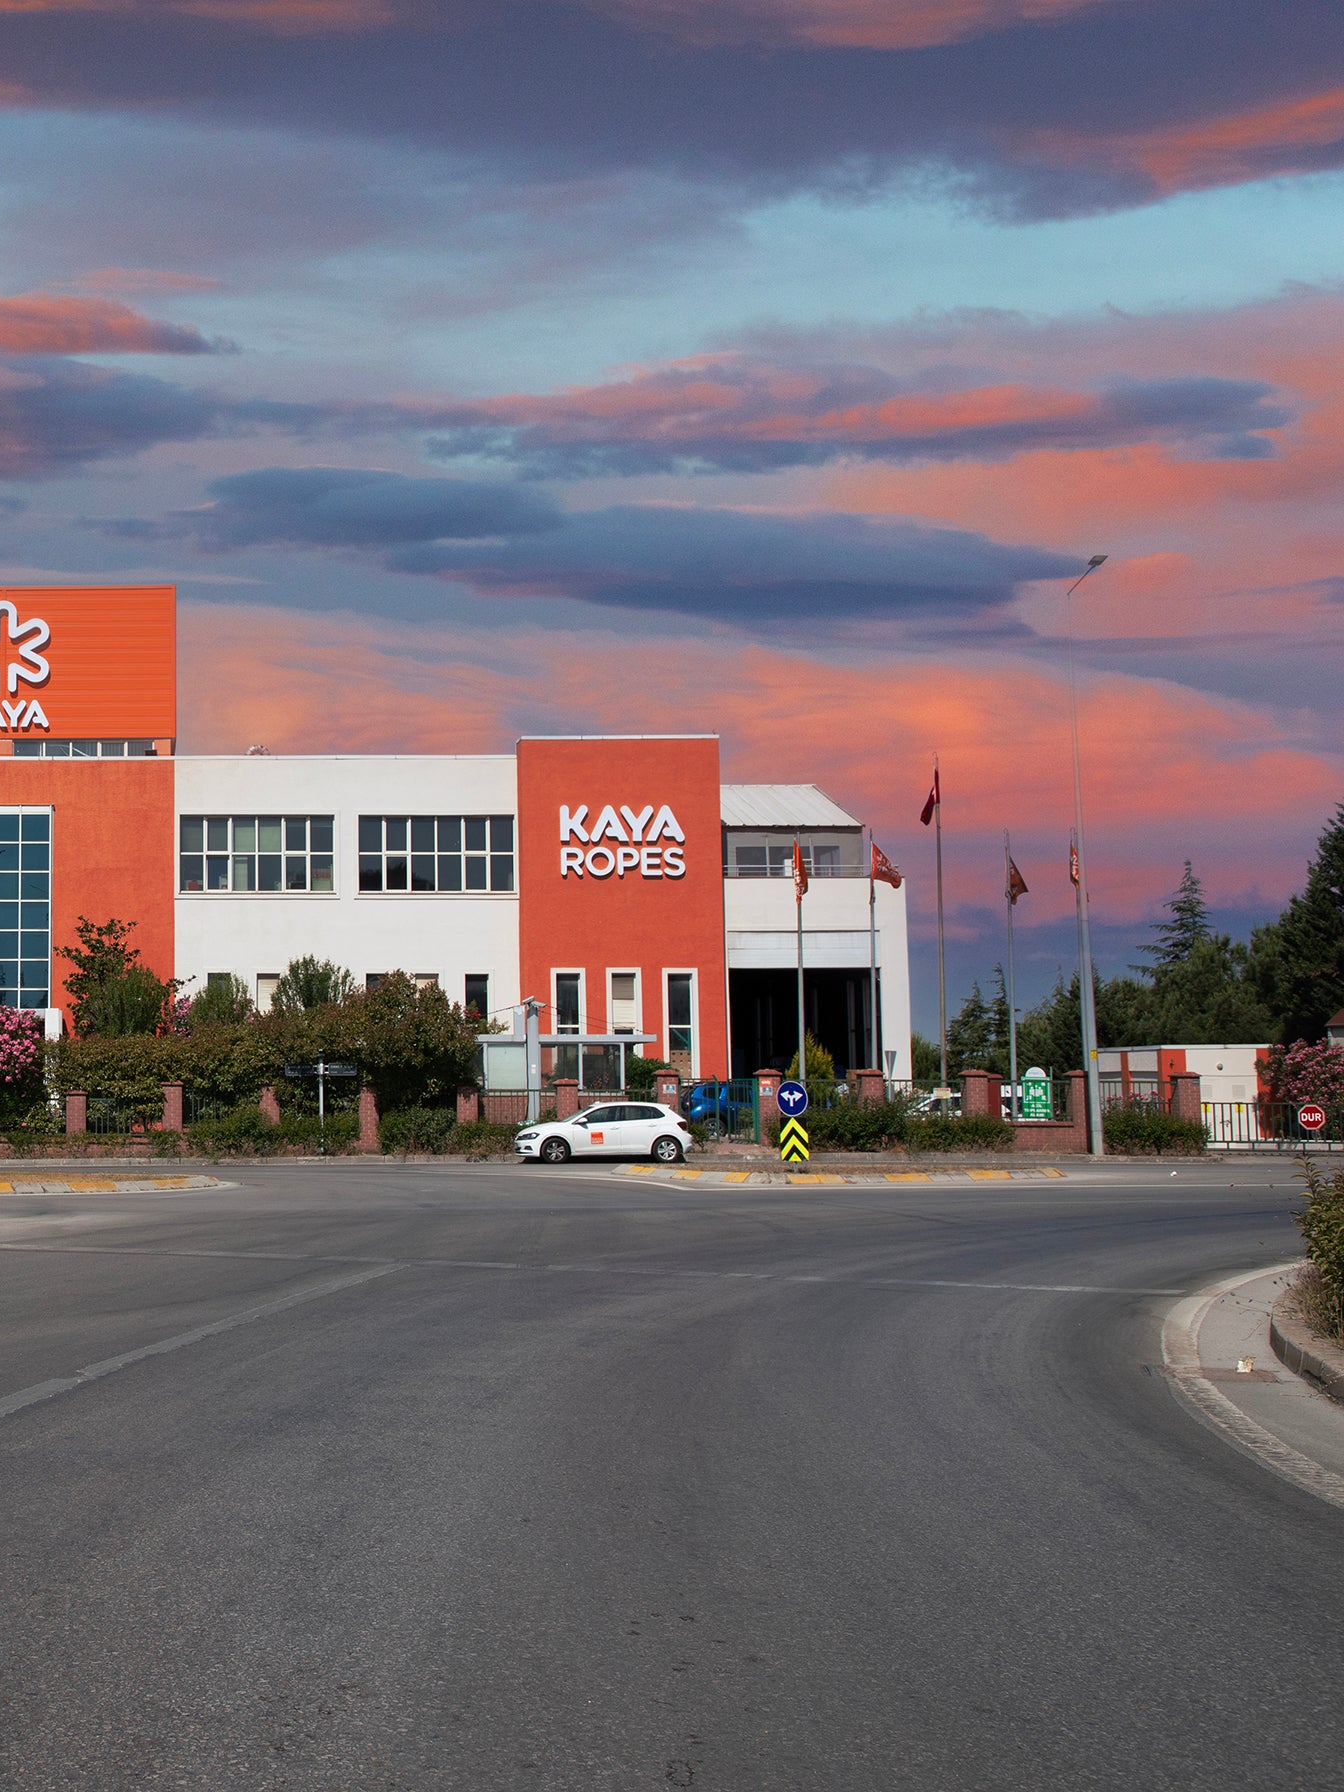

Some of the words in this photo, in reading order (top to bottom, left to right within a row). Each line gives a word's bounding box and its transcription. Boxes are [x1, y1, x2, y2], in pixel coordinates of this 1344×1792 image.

[559, 804, 686, 843] KAYA
[560, 846, 686, 877] ROPES
[1301, 1112, 1322, 1122] DUR
